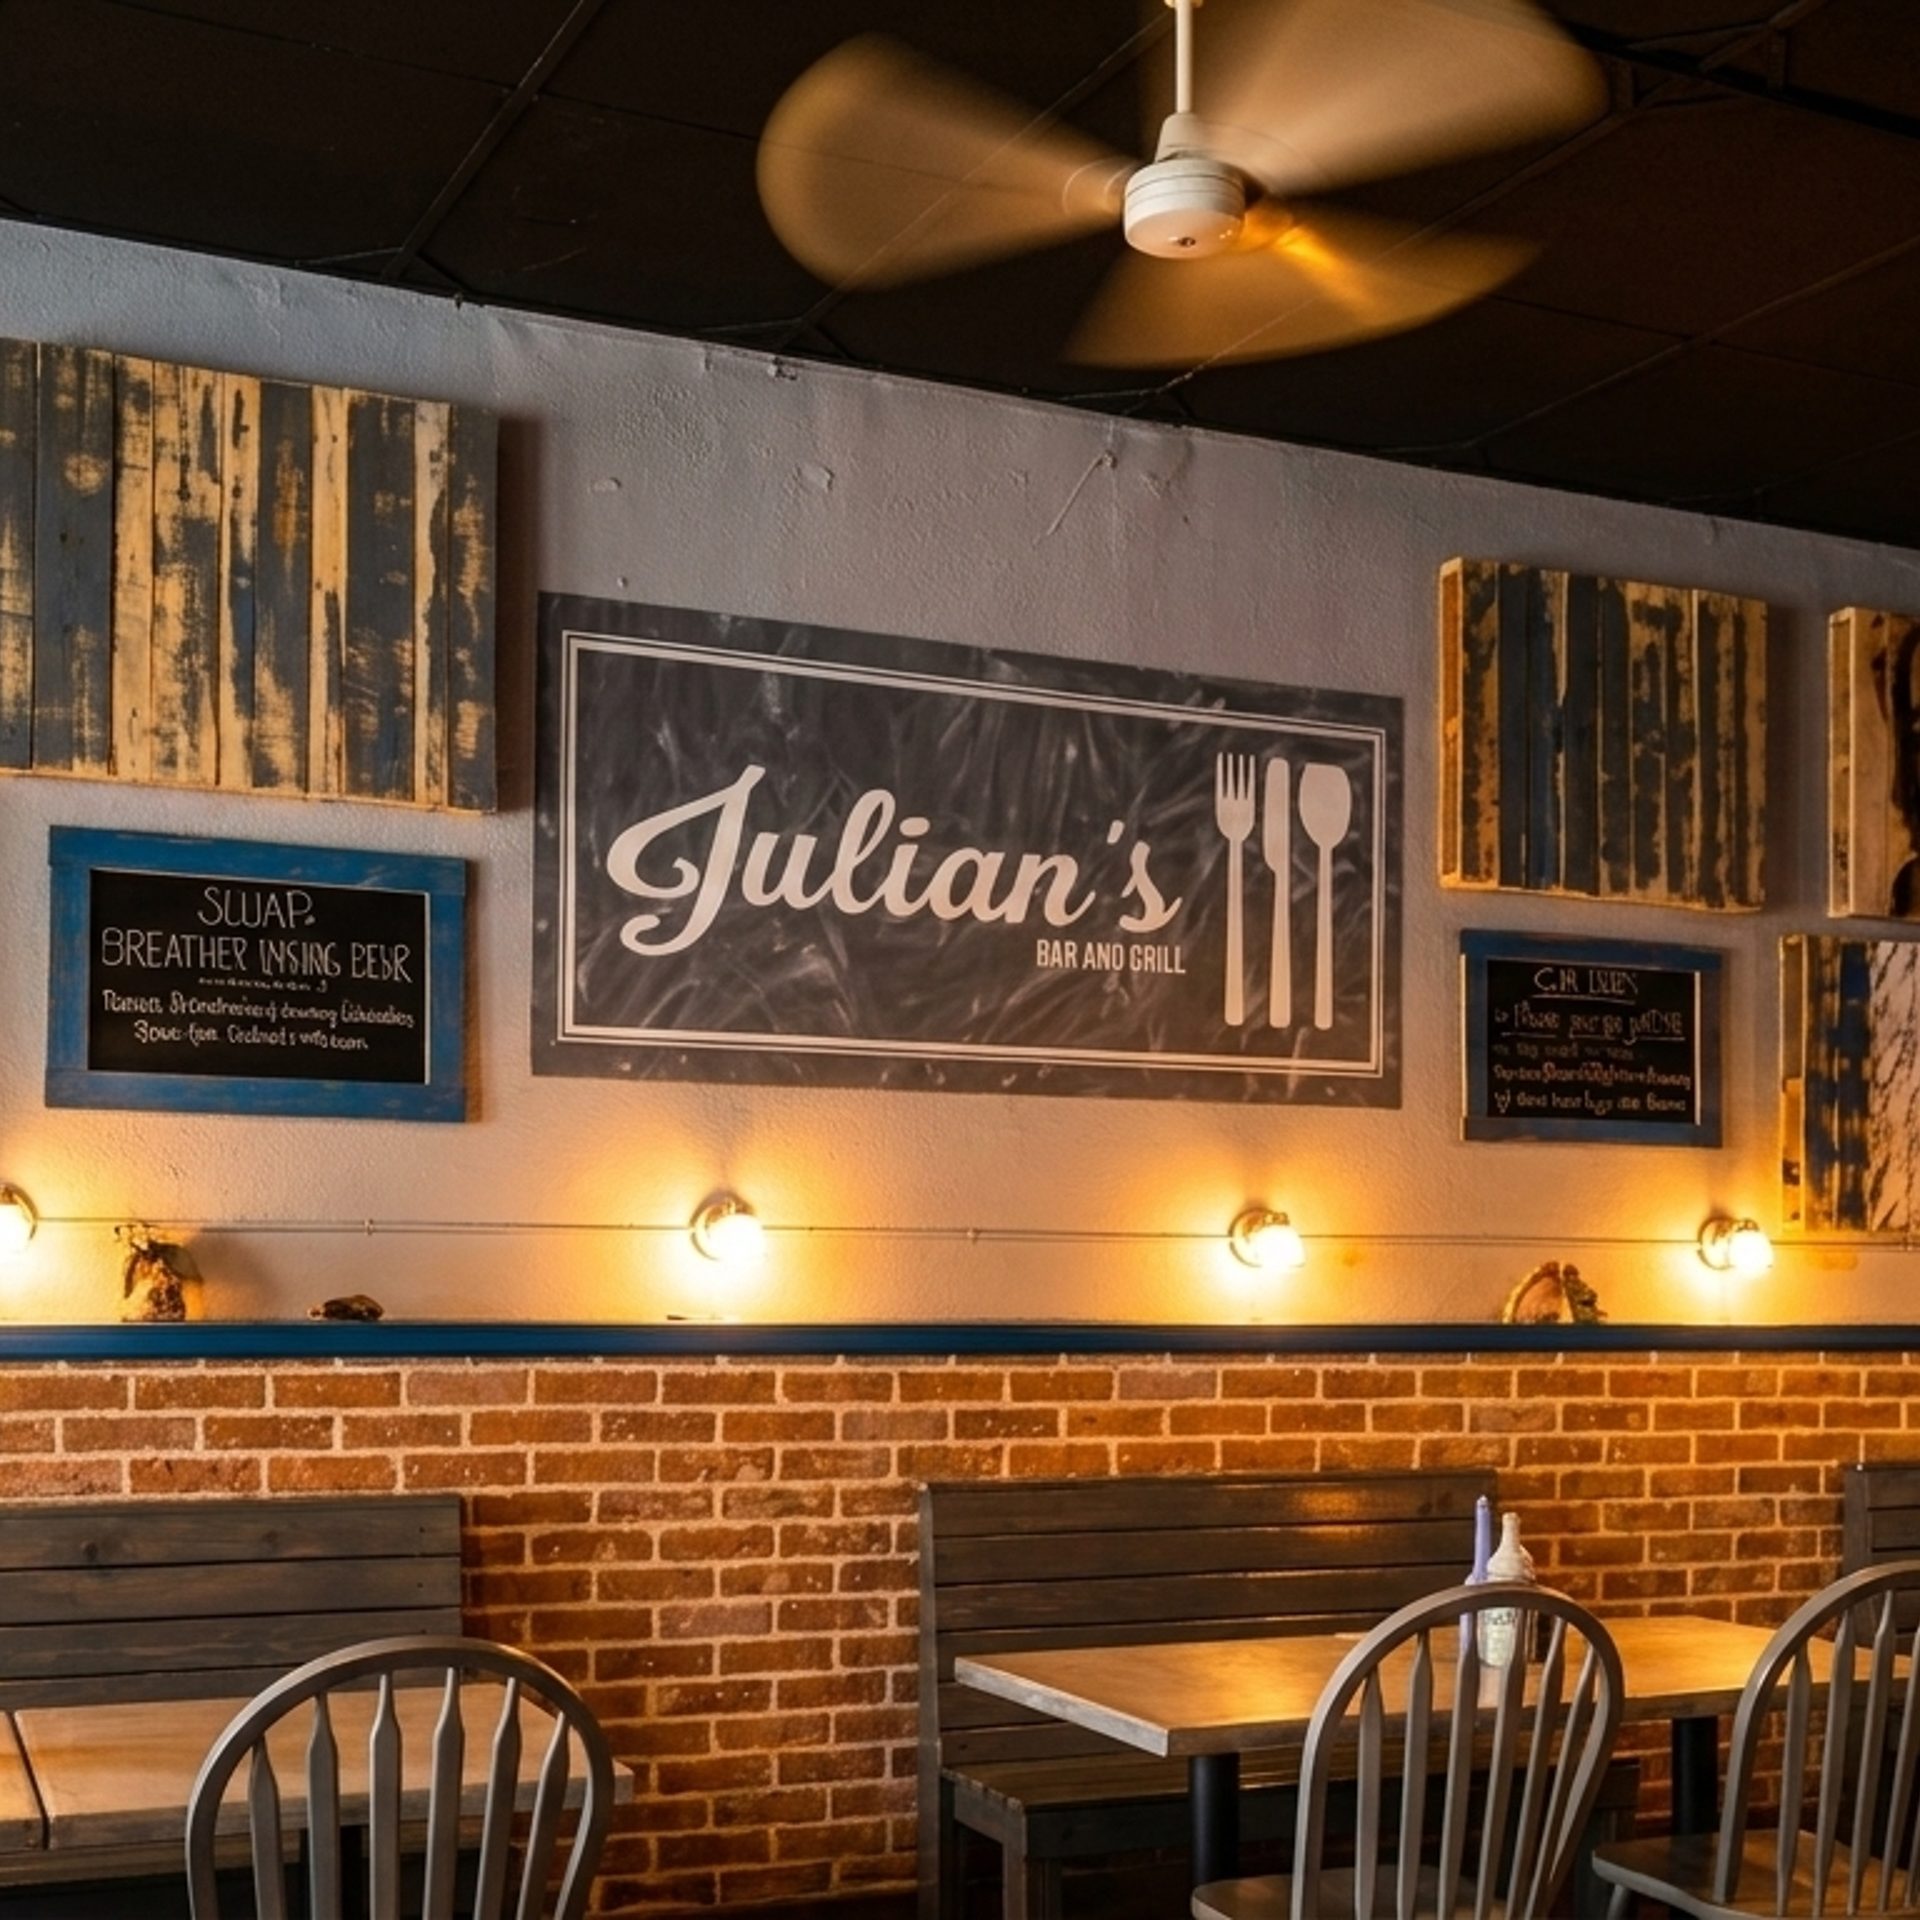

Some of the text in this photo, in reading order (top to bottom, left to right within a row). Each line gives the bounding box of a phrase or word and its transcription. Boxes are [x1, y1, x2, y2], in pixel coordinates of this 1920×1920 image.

[606, 764, 1184, 956] Julian's
[102, 927, 247, 971] BREATHER
[1036, 938, 1078, 969] BAR
[1129, 944, 1187, 974] GRILL
